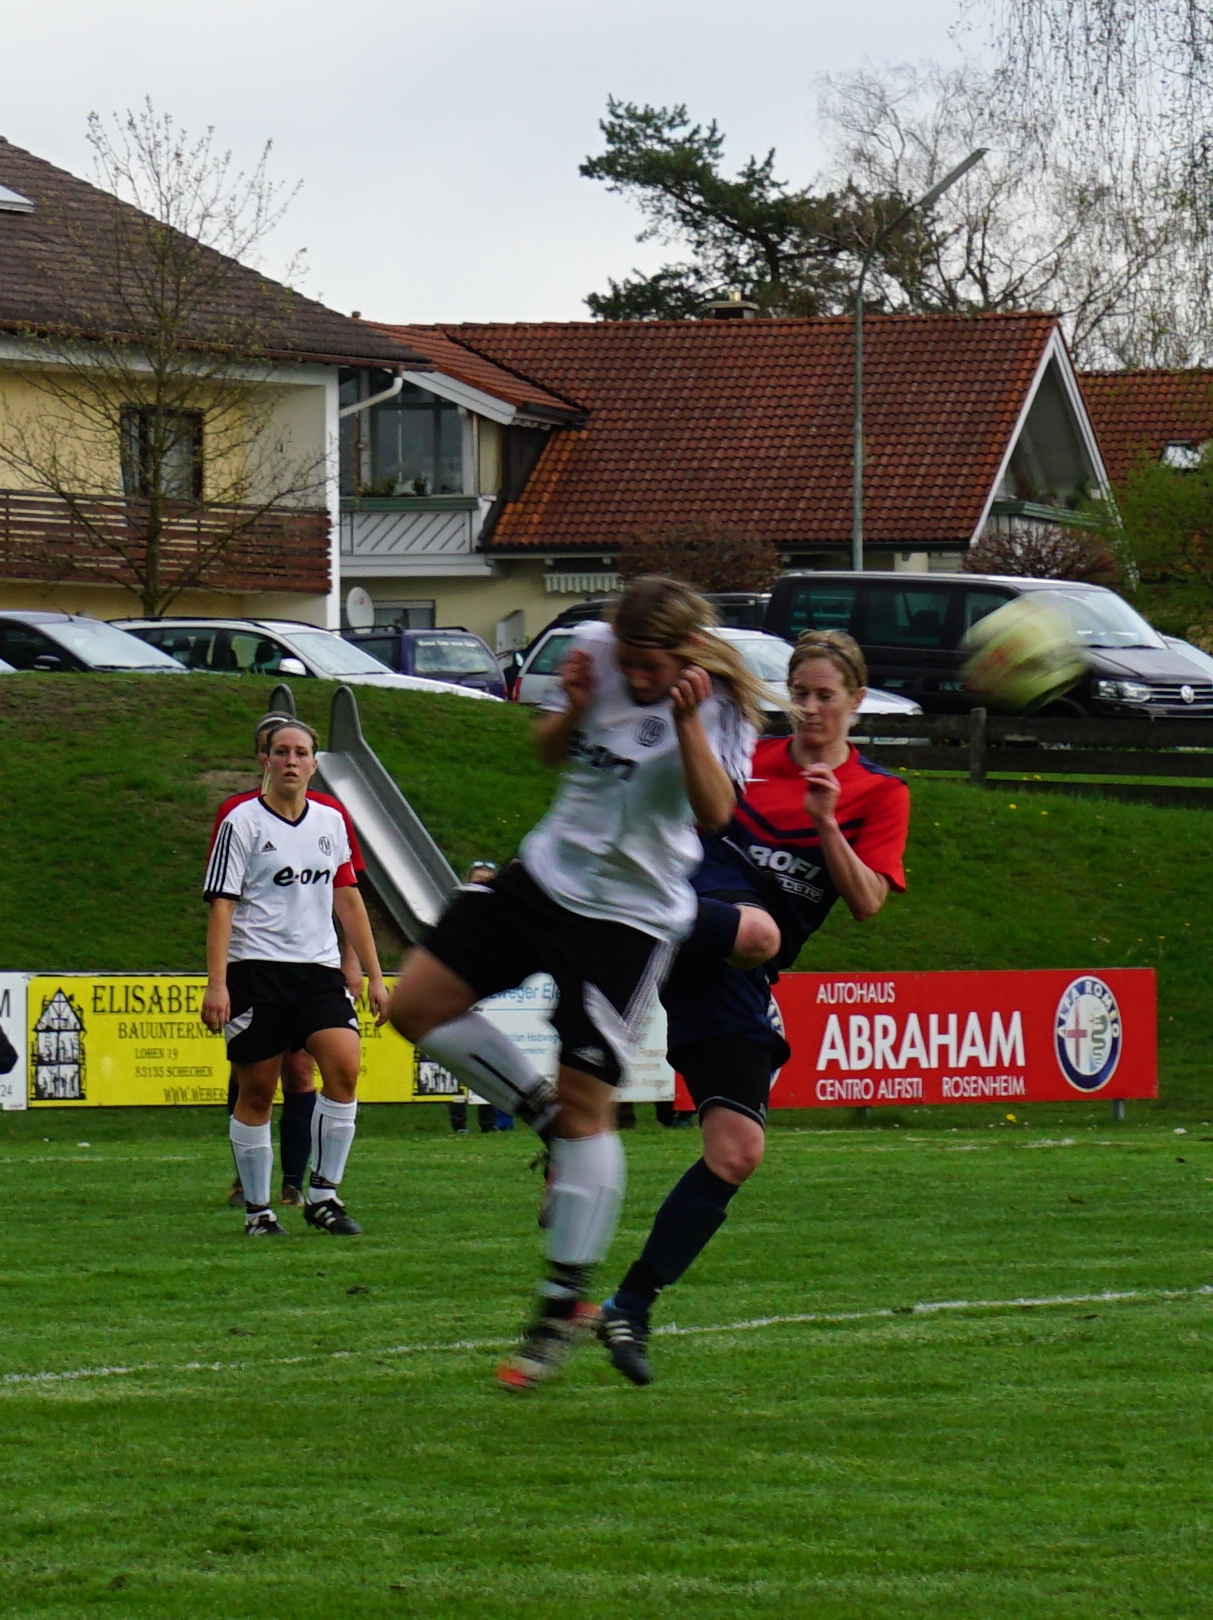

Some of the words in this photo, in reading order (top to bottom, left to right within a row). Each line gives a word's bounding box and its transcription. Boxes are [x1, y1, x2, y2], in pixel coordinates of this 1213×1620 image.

[816, 982, 895, 1004] AUTOHAUS
[1085, 981, 1120, 1038] ROMEO
[816, 1010, 1026, 1071] ABRAHAM
[816, 1078, 874, 1100] CENTRO
[877, 1077, 923, 1099] ALFISTI
[942, 1075, 1025, 1098] ROSENHEIM
